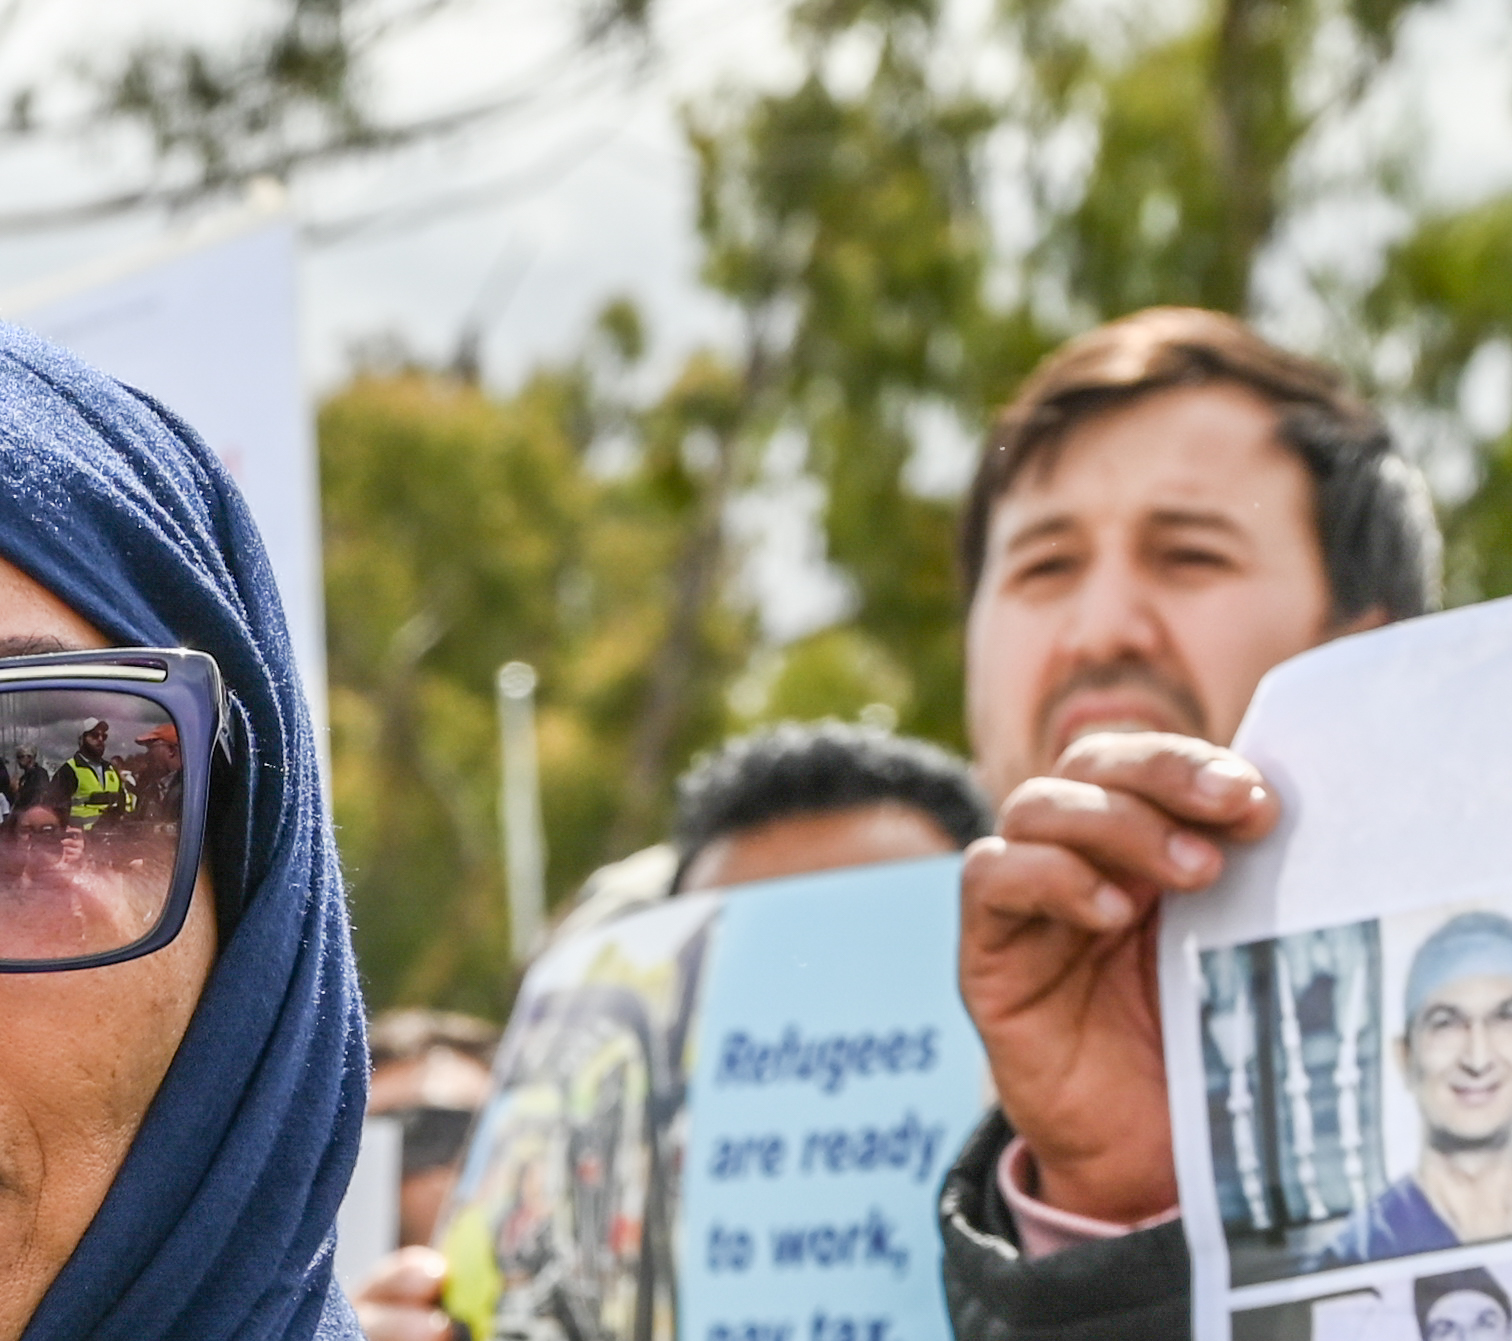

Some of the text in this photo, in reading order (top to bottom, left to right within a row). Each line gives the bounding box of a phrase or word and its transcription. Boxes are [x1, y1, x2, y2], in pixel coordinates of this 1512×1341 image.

[713, 1020, 940, 1093] Refugees
[708, 1112, 948, 1184] are ready
[706, 1211, 909, 1279] to work,
